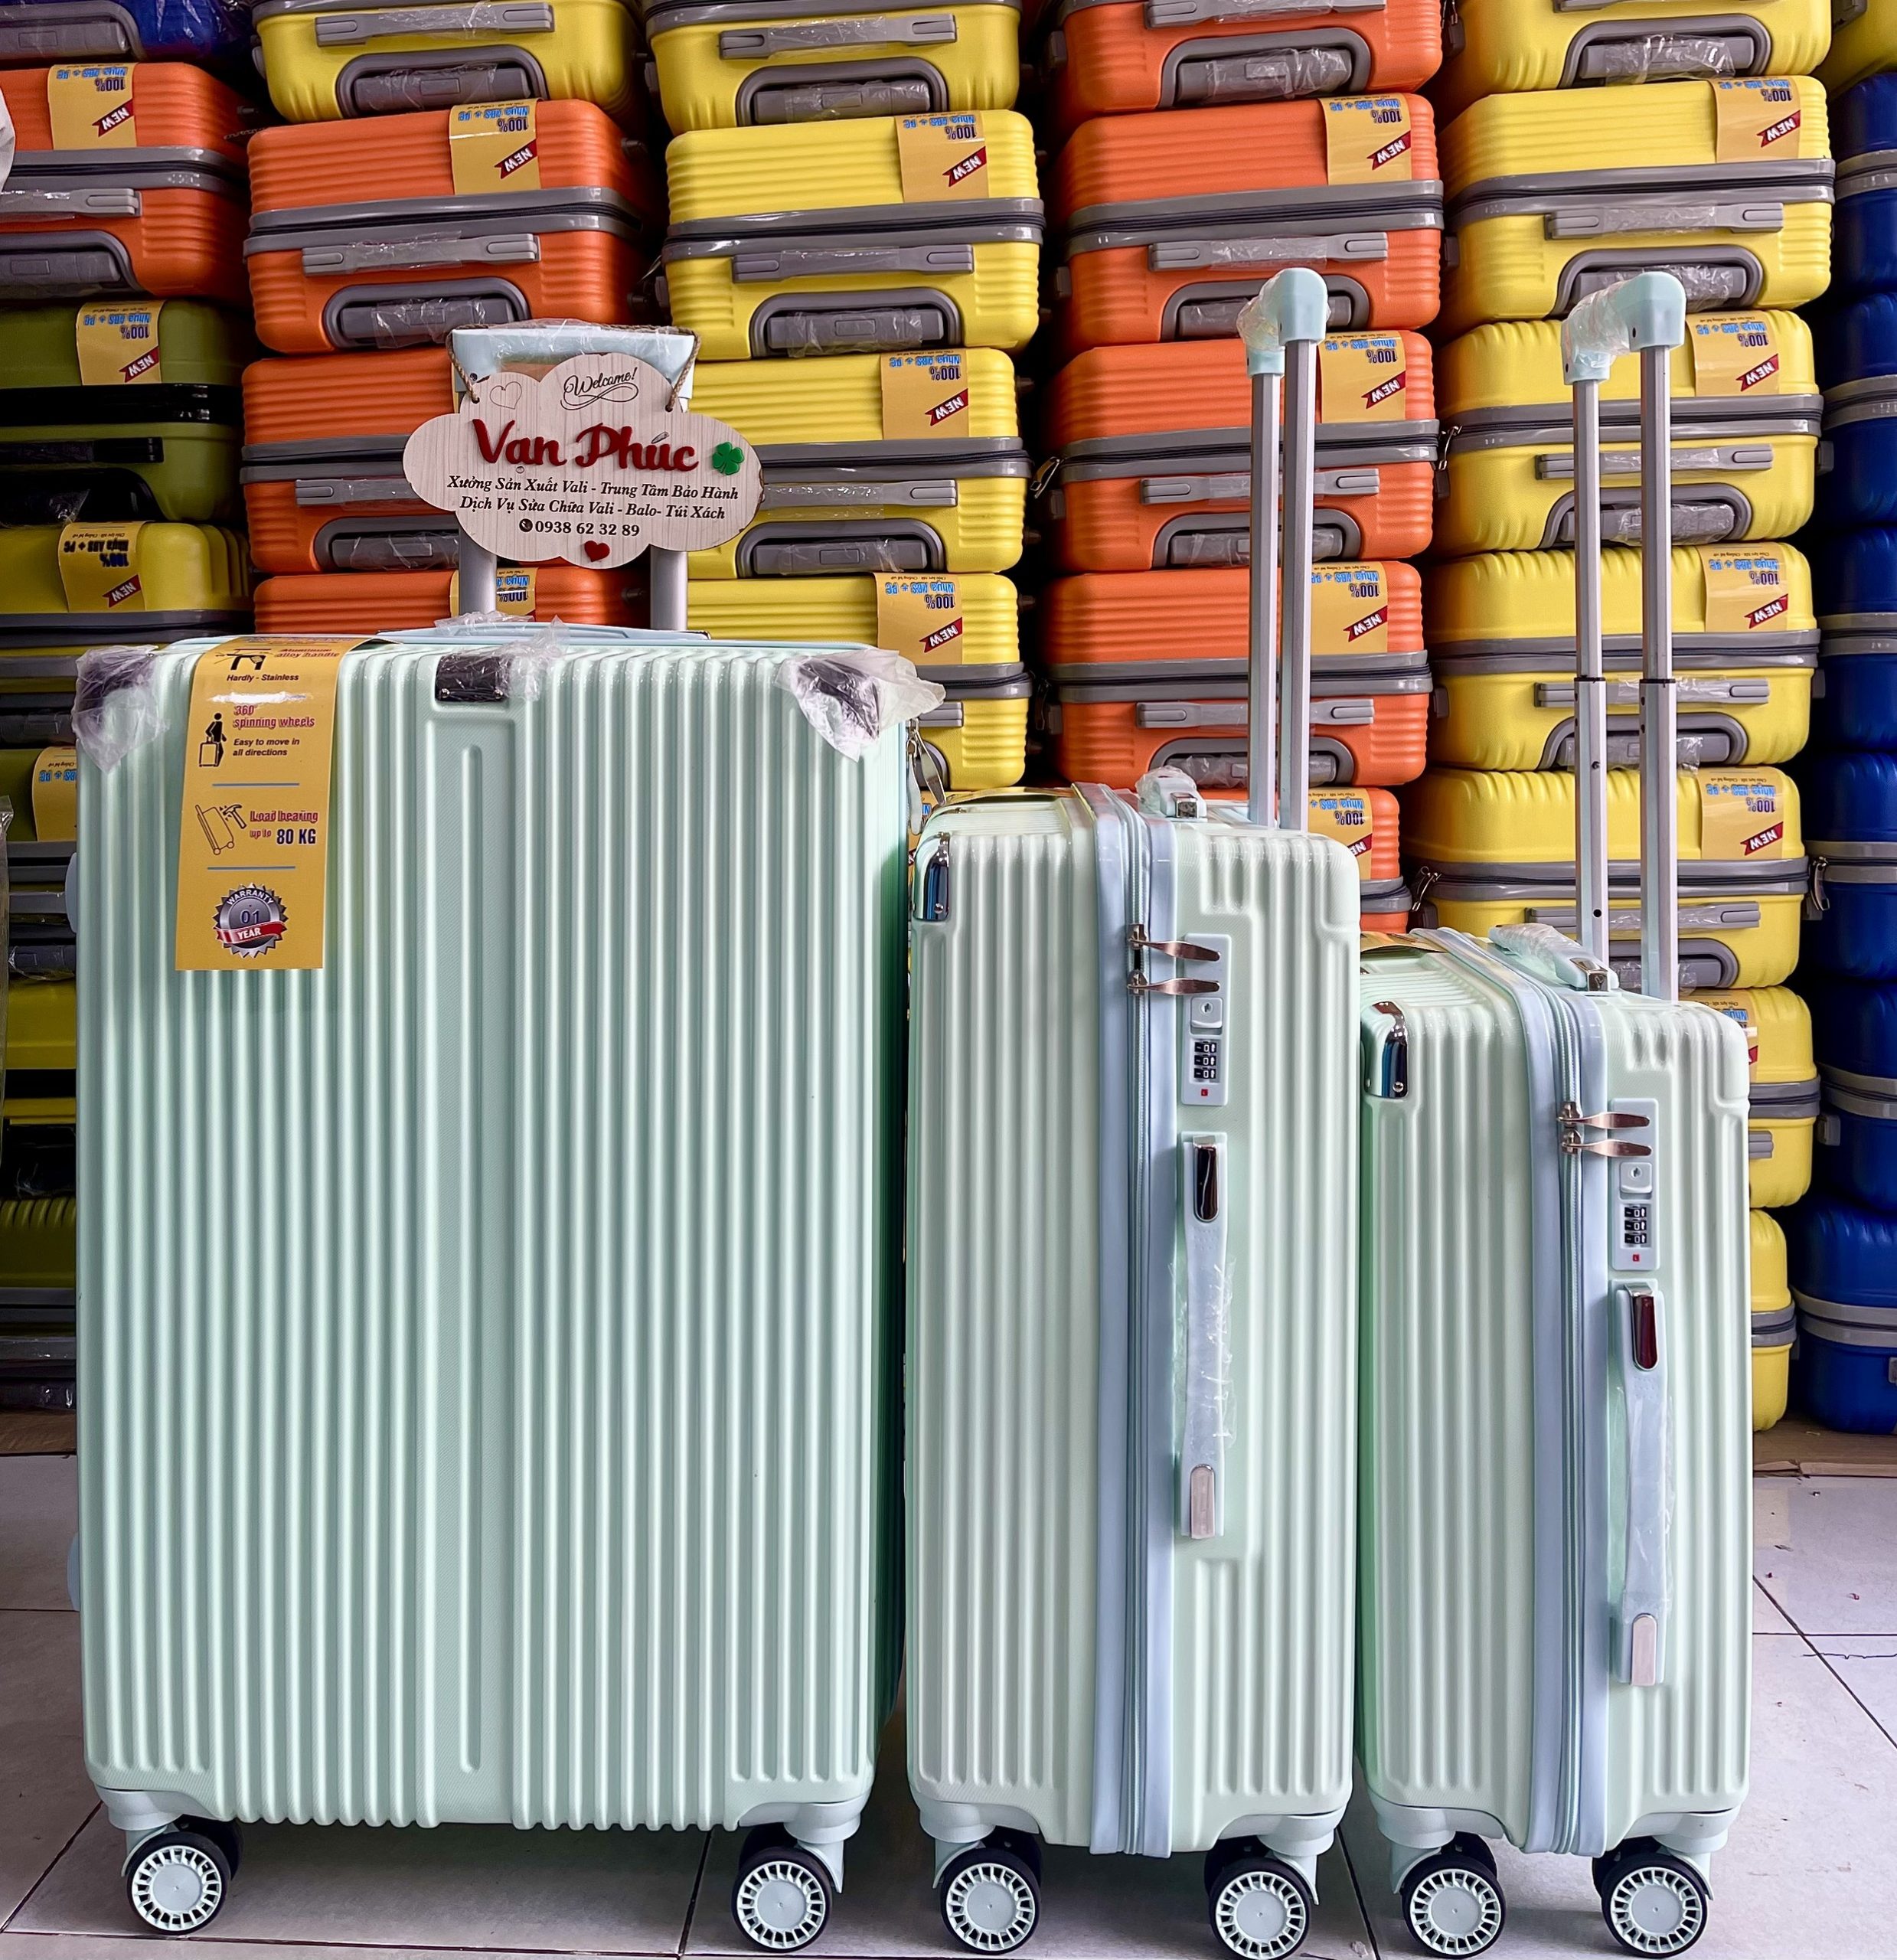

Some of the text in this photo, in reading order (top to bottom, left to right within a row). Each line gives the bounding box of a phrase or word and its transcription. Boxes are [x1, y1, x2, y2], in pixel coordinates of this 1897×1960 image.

[94, 78, 125, 91] 100%
[1760, 89, 1792, 102] 100%
[102, 107, 129, 129] NEW
[1371, 109, 1402, 123] 100%
[497, 117, 528, 132] 100%
[1767, 118, 1796, 141] NEW
[945, 125, 977, 140] 100%
[1377, 139, 1406, 163] NEW
[504, 148, 533, 172] NEW
[953, 155, 981, 179] NEW
[119, 325, 149, 339] 100%
[1737, 333, 1768, 347] 100%
[1366, 349, 1397, 364] 100%
[129, 355, 154, 376] NEW
[1746, 362, 1775, 384] NEW
[929, 366, 961, 381] 100%
[563, 367, 638, 398] Welcome!
[1372, 380, 1400, 402] NEW
[935, 397, 964, 420] NEW
[472, 419, 699, 473] Vạn Phúc
[447, 475, 492, 492] Xưởng
[495, 478, 521, 491] Sản
[524, 477, 559, 492] Xuất
[562, 480, 589, 493] Vali
[601, 482, 638, 498] Trung
[642, 484, 668, 497] Tâm
[671, 485, 698, 498] Bảo
[701, 486, 739, 499] Hành
[460, 496, 492, 513] Dịch
[497, 498, 514, 514] Vụ
[518, 498, 545, 511] Sửa
[549, 499, 584, 514] Chữa
[589, 501, 614, 514] Vali
[665, 505, 688, 518] Túi
[691, 505, 726, 519] Xách
[535, 521, 640, 536] 0938 62 32 89
[1749, 571, 1779, 585] 100%
[111, 583, 136, 601] NEW
[1349, 583, 1379, 598] 100%
[925, 595, 955, 609] 100%
[1754, 602, 1782, 622] NEW
[1353, 614, 1382, 635] NEW
[929, 626, 958, 647] NEW
[227, 674, 254, 683] Hardly
[233, 717, 315, 730] spinning wheels
[233, 738, 254, 747] Easy
[1745, 798, 1775, 812] 100%
[250, 810, 318, 824] Load bearing
[1334, 811, 1364, 825] 100%
[250, 828, 316, 844] up to 80 KG
[1750, 829, 1778, 850] NEW
[1348, 841, 1366, 854] NE
[227, 889, 274, 905] WARRANTY
[240, 909, 260, 924] 01
[237, 927, 261, 940] YEAR
